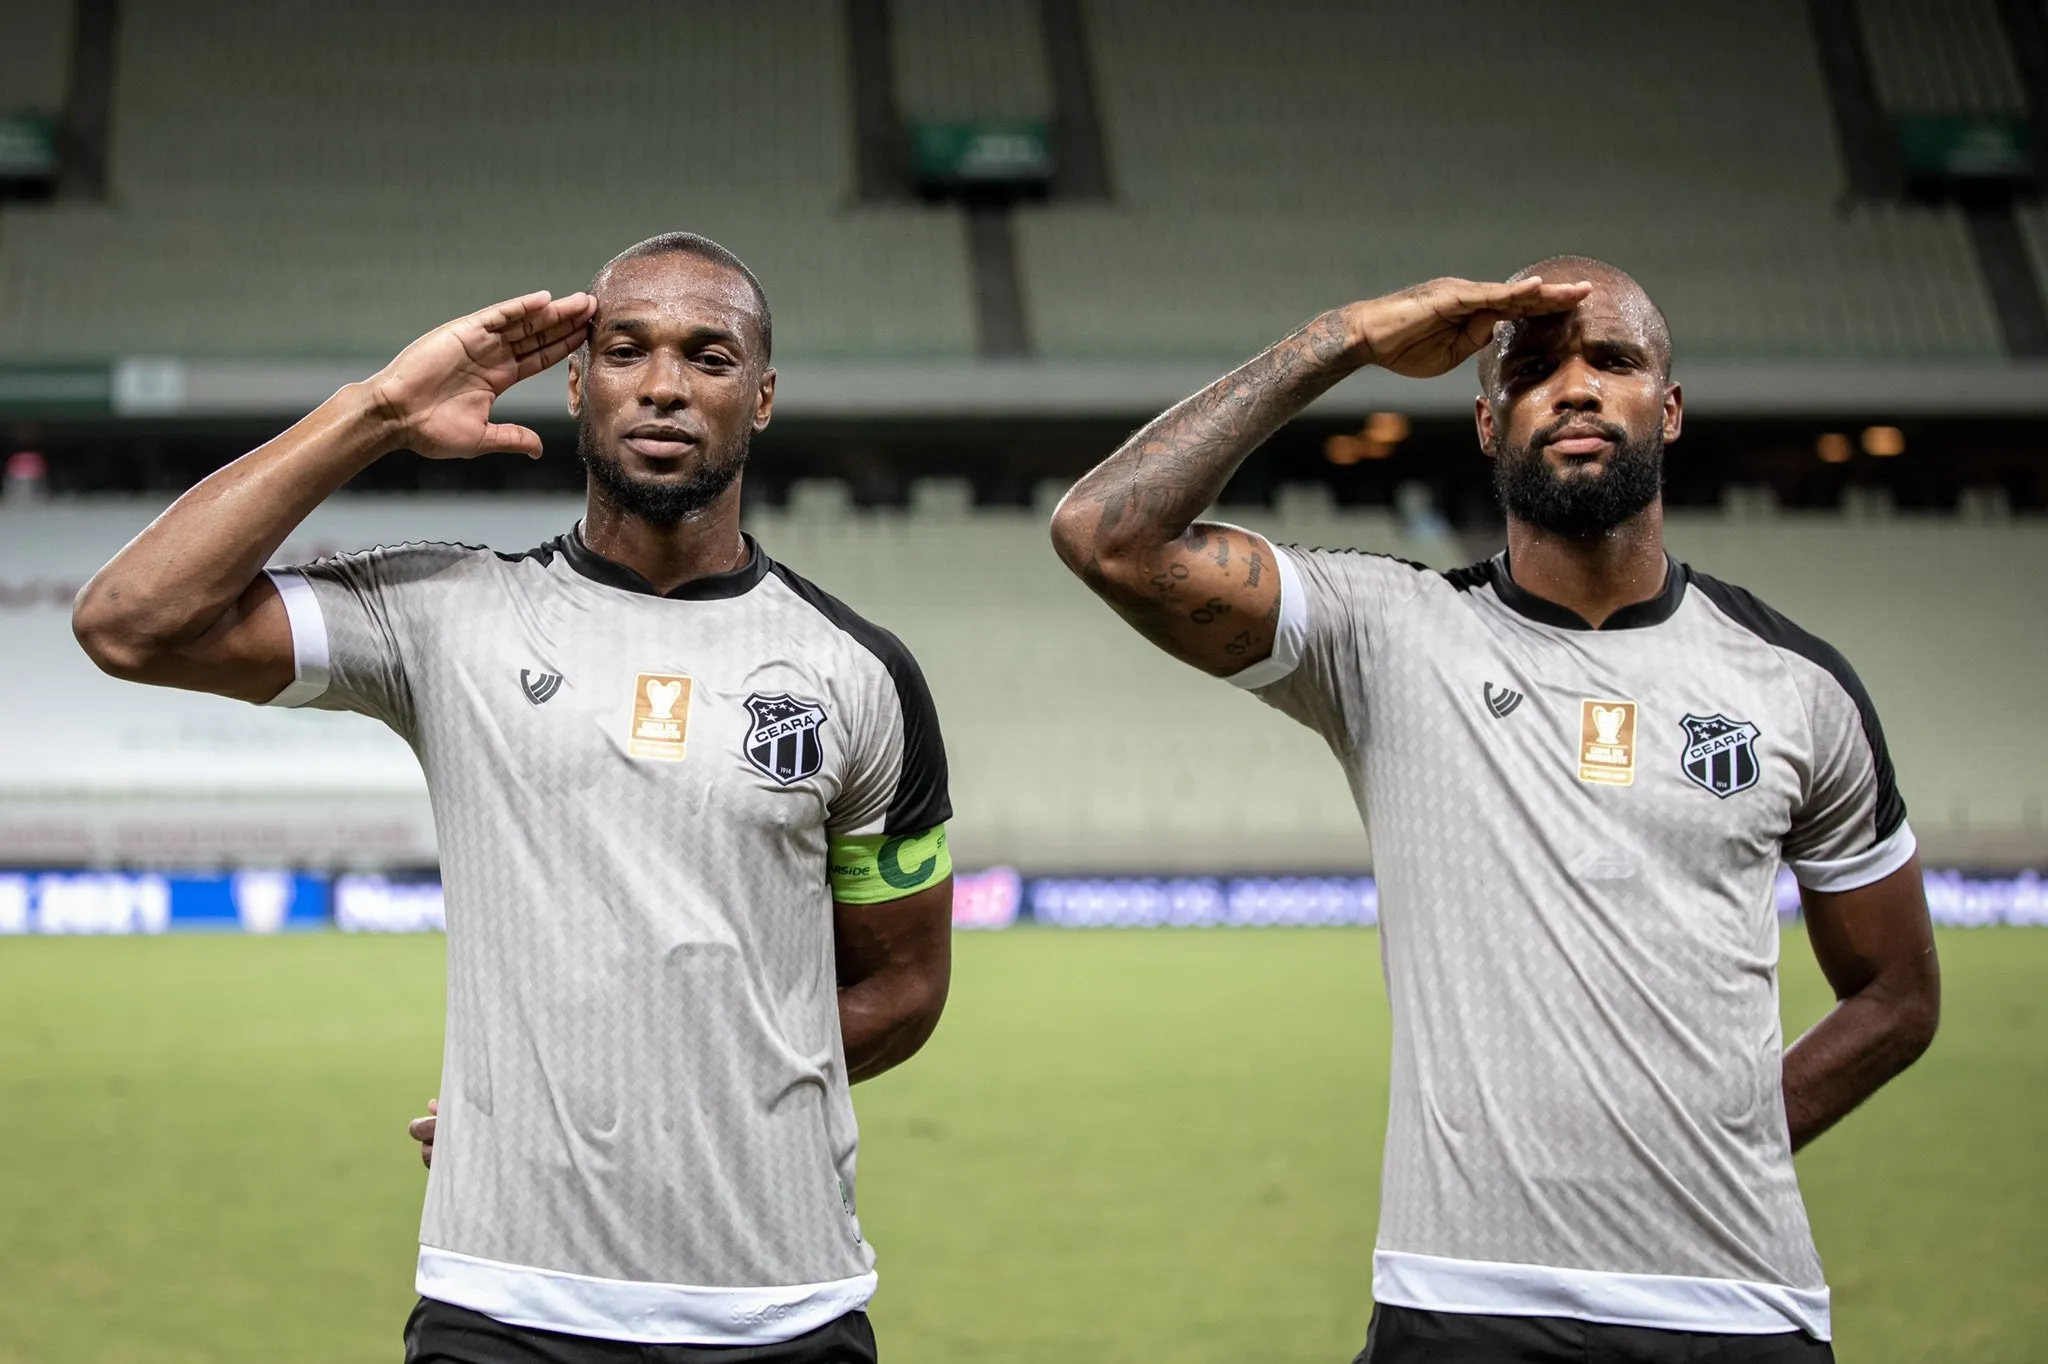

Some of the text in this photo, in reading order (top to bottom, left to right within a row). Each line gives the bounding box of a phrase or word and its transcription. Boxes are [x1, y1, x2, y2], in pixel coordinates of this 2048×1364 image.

[754, 713, 815, 743] CEARÁ
[1690, 730, 1748, 759] CEARÁ
[780, 766, 792, 774] 1914
[877, 828, 937, 889] C
